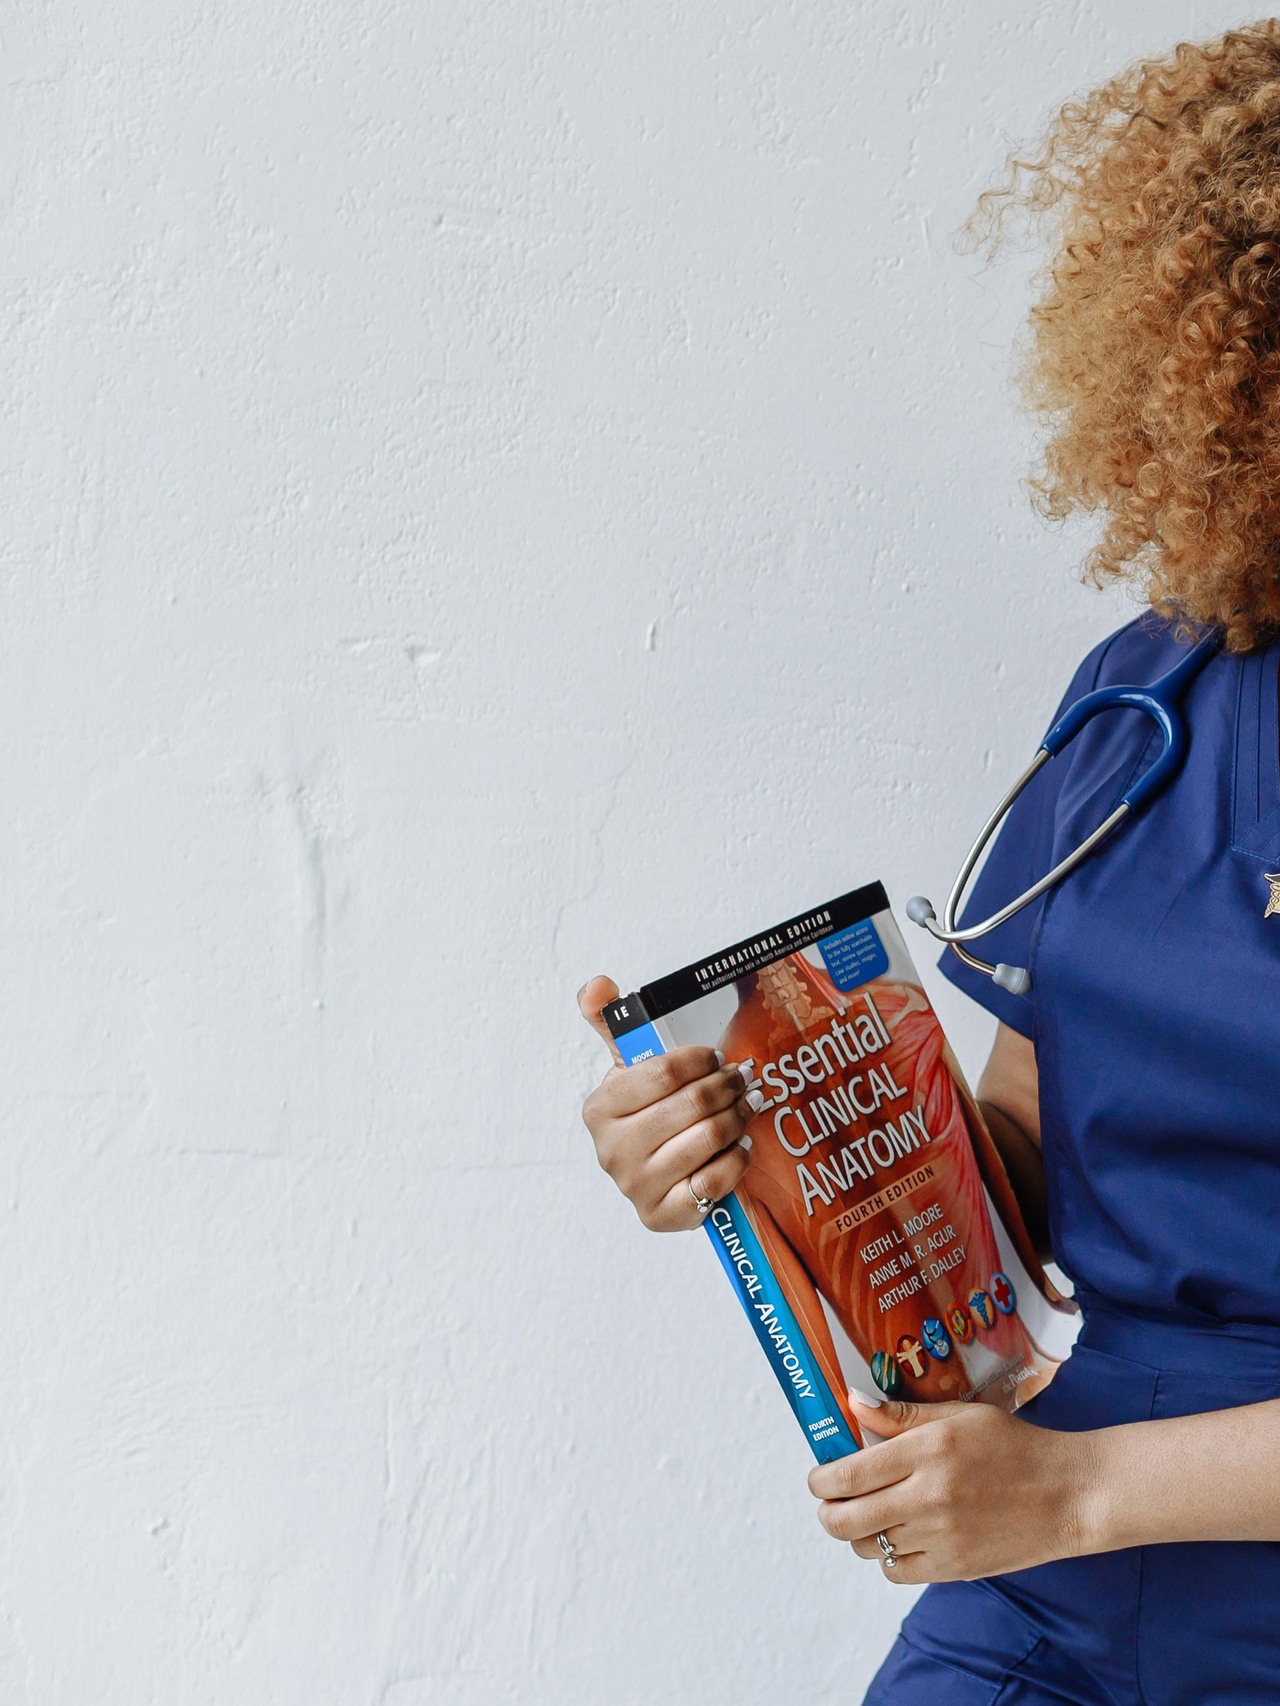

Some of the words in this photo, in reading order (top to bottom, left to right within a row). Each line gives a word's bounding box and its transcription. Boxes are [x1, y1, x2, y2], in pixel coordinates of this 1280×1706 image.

[694, 934, 783, 982] INTERNATIONAL
[786, 910, 831, 939] EDITION
[701, 982, 711, 991] Not
[760, 952, 774, 963] North
[774, 943, 794, 956] America
[793, 940, 803, 948] and
[810, 924, 834, 939] Caribbean
[630, 1048, 655, 1065] MOORE
[773, 1062, 908, 1158] CLINICAL
[795, 1104, 932, 1217] ANATOMY
[835, 1197, 885, 1233] FOURTH
[885, 1164, 935, 1202] EDITION
[859, 1233, 894, 1264] KEITH
[892, 1229, 905, 1244] L.
[902, 1202, 945, 1238] MOORE
[868, 1258, 902, 1290] ANNE
[900, 1251, 916, 1270] M.
[913, 1243, 928, 1260] R.
[926, 1223, 957, 1253] AGUR
[711, 1207, 763, 1300] CLINICAL
[753, 1302, 816, 1399] ANATOMY
[877, 1275, 922, 1314] ARTHUR
[920, 1269, 932, 1286] F.
[929, 1244, 968, 1280] DALLEY
[808, 1415, 835, 1432] FOURTH
[812, 1425, 840, 1442] EDITION
